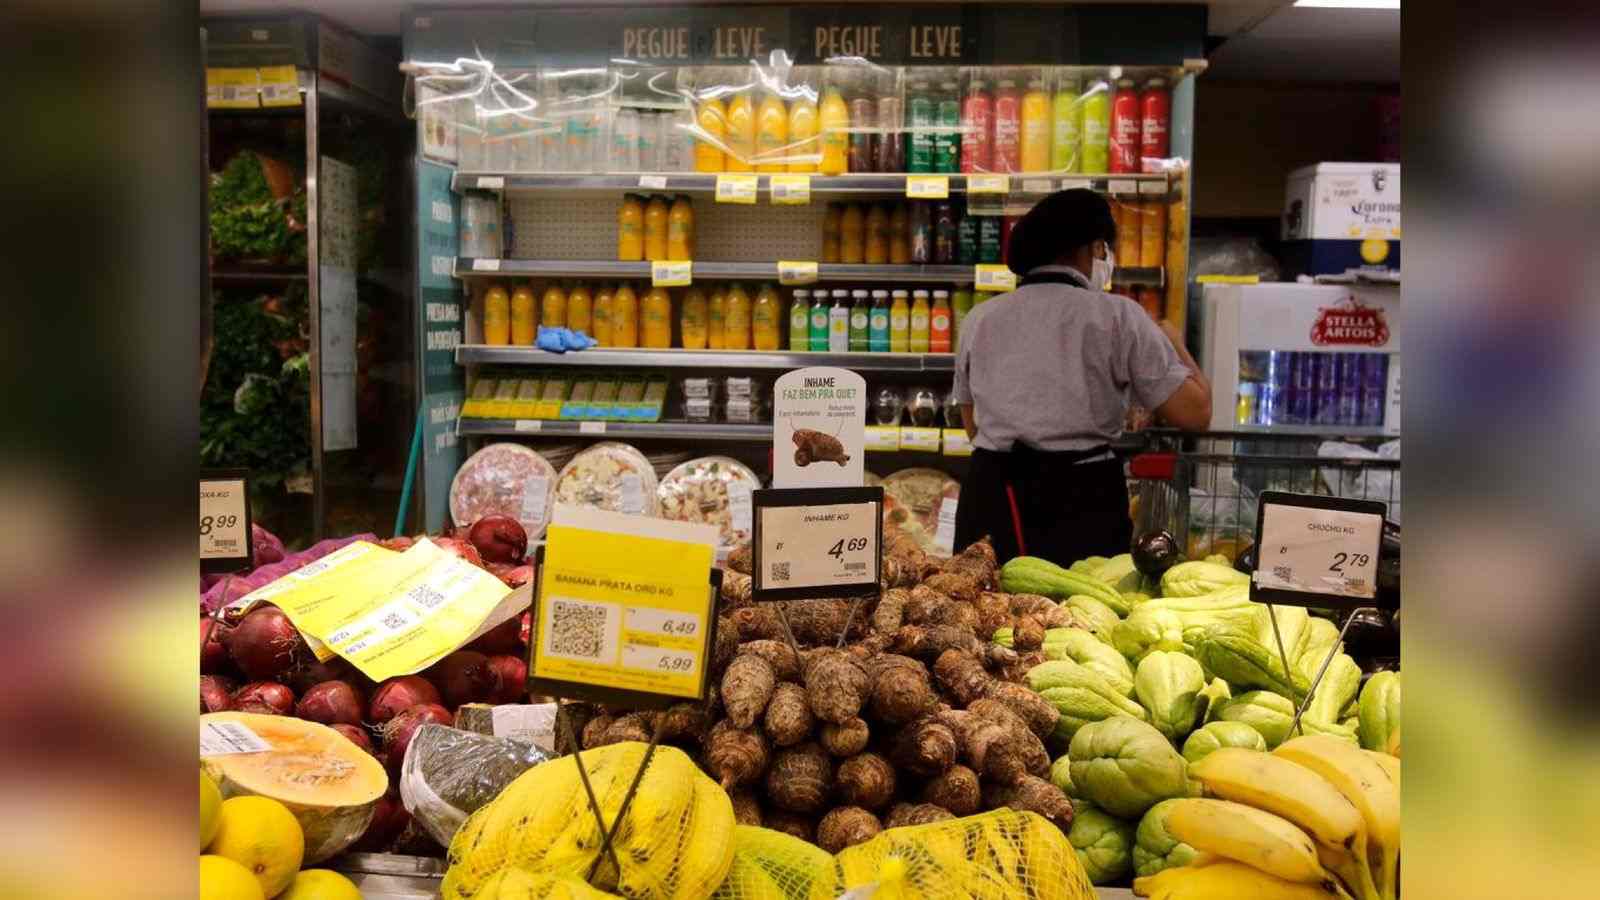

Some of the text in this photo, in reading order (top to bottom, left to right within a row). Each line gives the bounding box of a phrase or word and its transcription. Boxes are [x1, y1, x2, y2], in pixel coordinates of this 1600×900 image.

[623, 27, 766, 58] PEGUE LEVE
[815, 26, 961, 58] PEGUE LEVE
[1325, 316, 1375, 327] STELLA
[1324, 327, 1376, 338] ARTOIS
[803, 377, 835, 388] INHAME
[782, 389, 797, 400] FAZ
[799, 389, 817, 400] BEM
[818, 389, 834, 399] PRA
[804, 512, 835, 522] INHAME
[200, 515, 237, 540] 8,99
[828, 537, 868, 564] 4,69
[1329, 552, 1369, 577] 2,79
[555, 574, 597, 586] BANANA
[599, 580, 633, 592] PRATA
[662, 620, 697, 635] 6,49
[658, 656, 693, 672] 5,99
